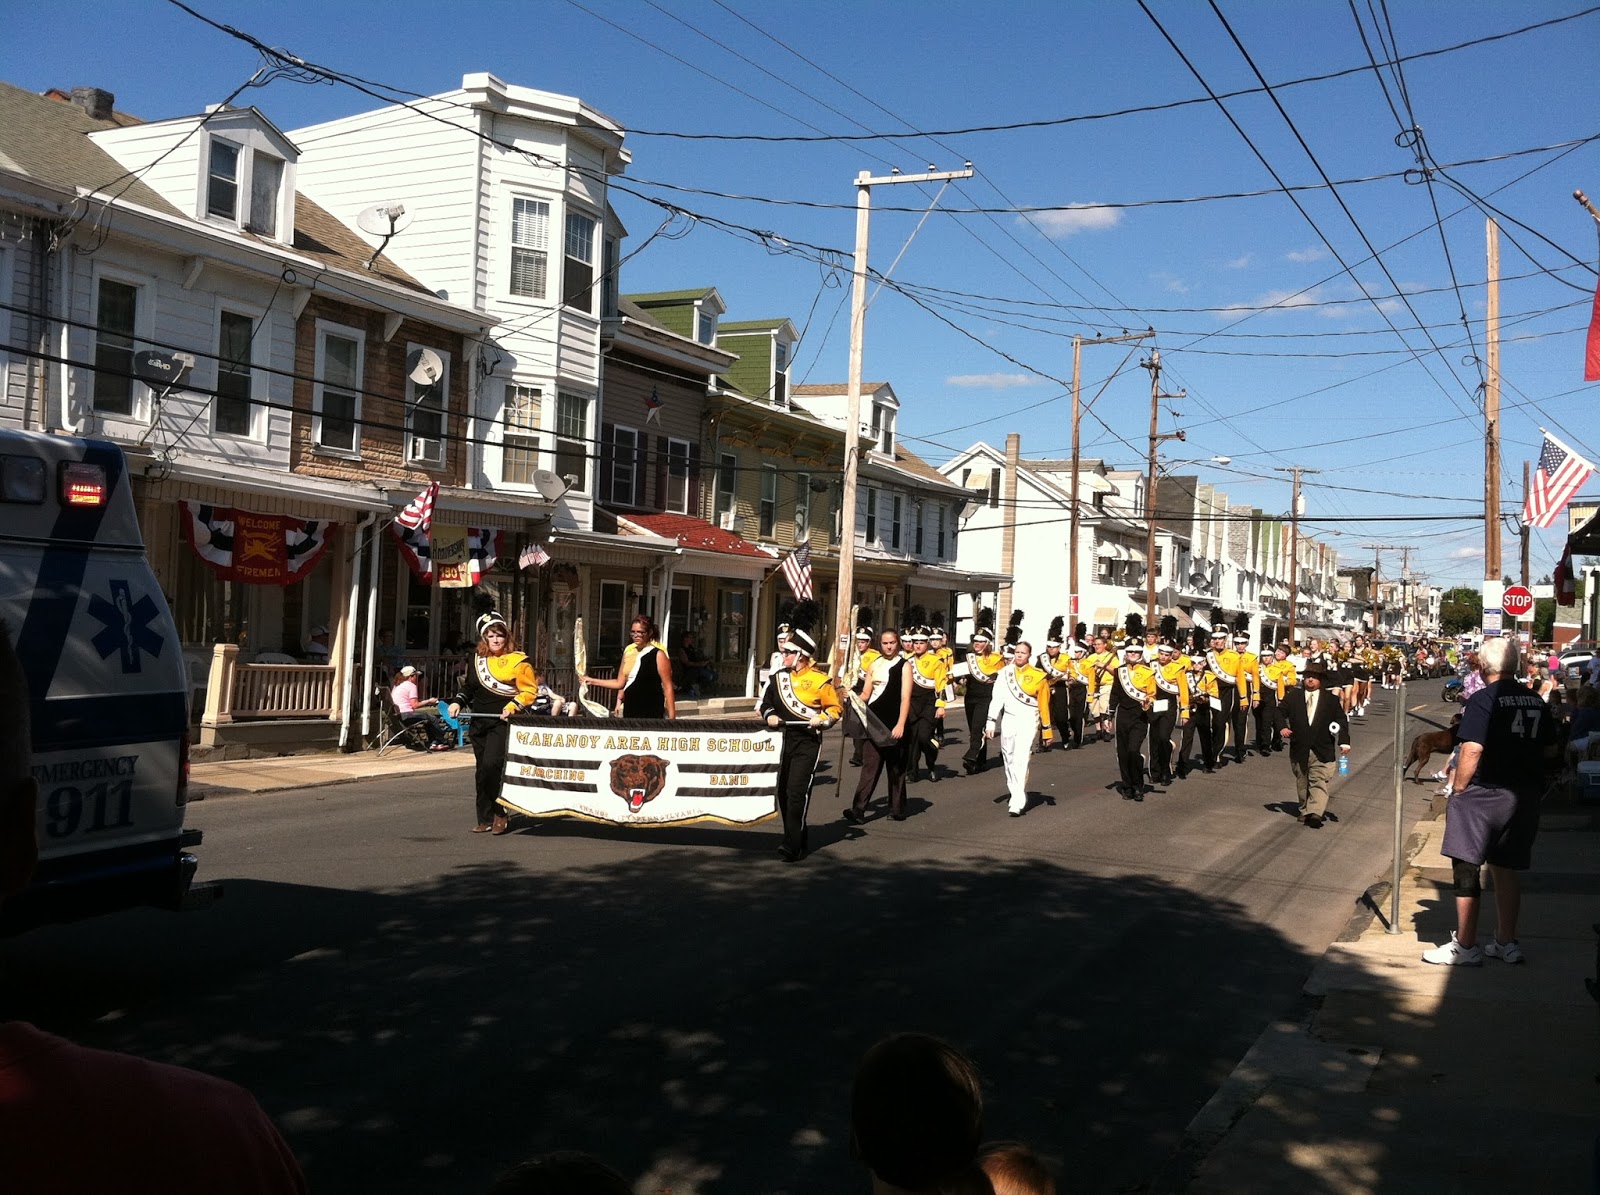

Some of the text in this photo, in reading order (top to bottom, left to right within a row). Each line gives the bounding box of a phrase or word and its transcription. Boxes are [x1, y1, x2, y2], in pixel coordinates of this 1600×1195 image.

[238, 516, 281, 530] WELCOME
[237, 565, 281, 577] FIREMEN
[1503, 594, 1531, 607] STOP
[478, 656, 499, 689] EARS
[782, 677, 807, 714] BEARS
[1498, 695, 1544, 707] FIRE DISTRIC
[1511, 709, 1541, 738] 47
[517, 731, 775, 752] MAHANOY AREA HIGH SCHOOL
[520, 765, 749, 786] MARCHING BAND
[46, 779, 134, 838] 911
